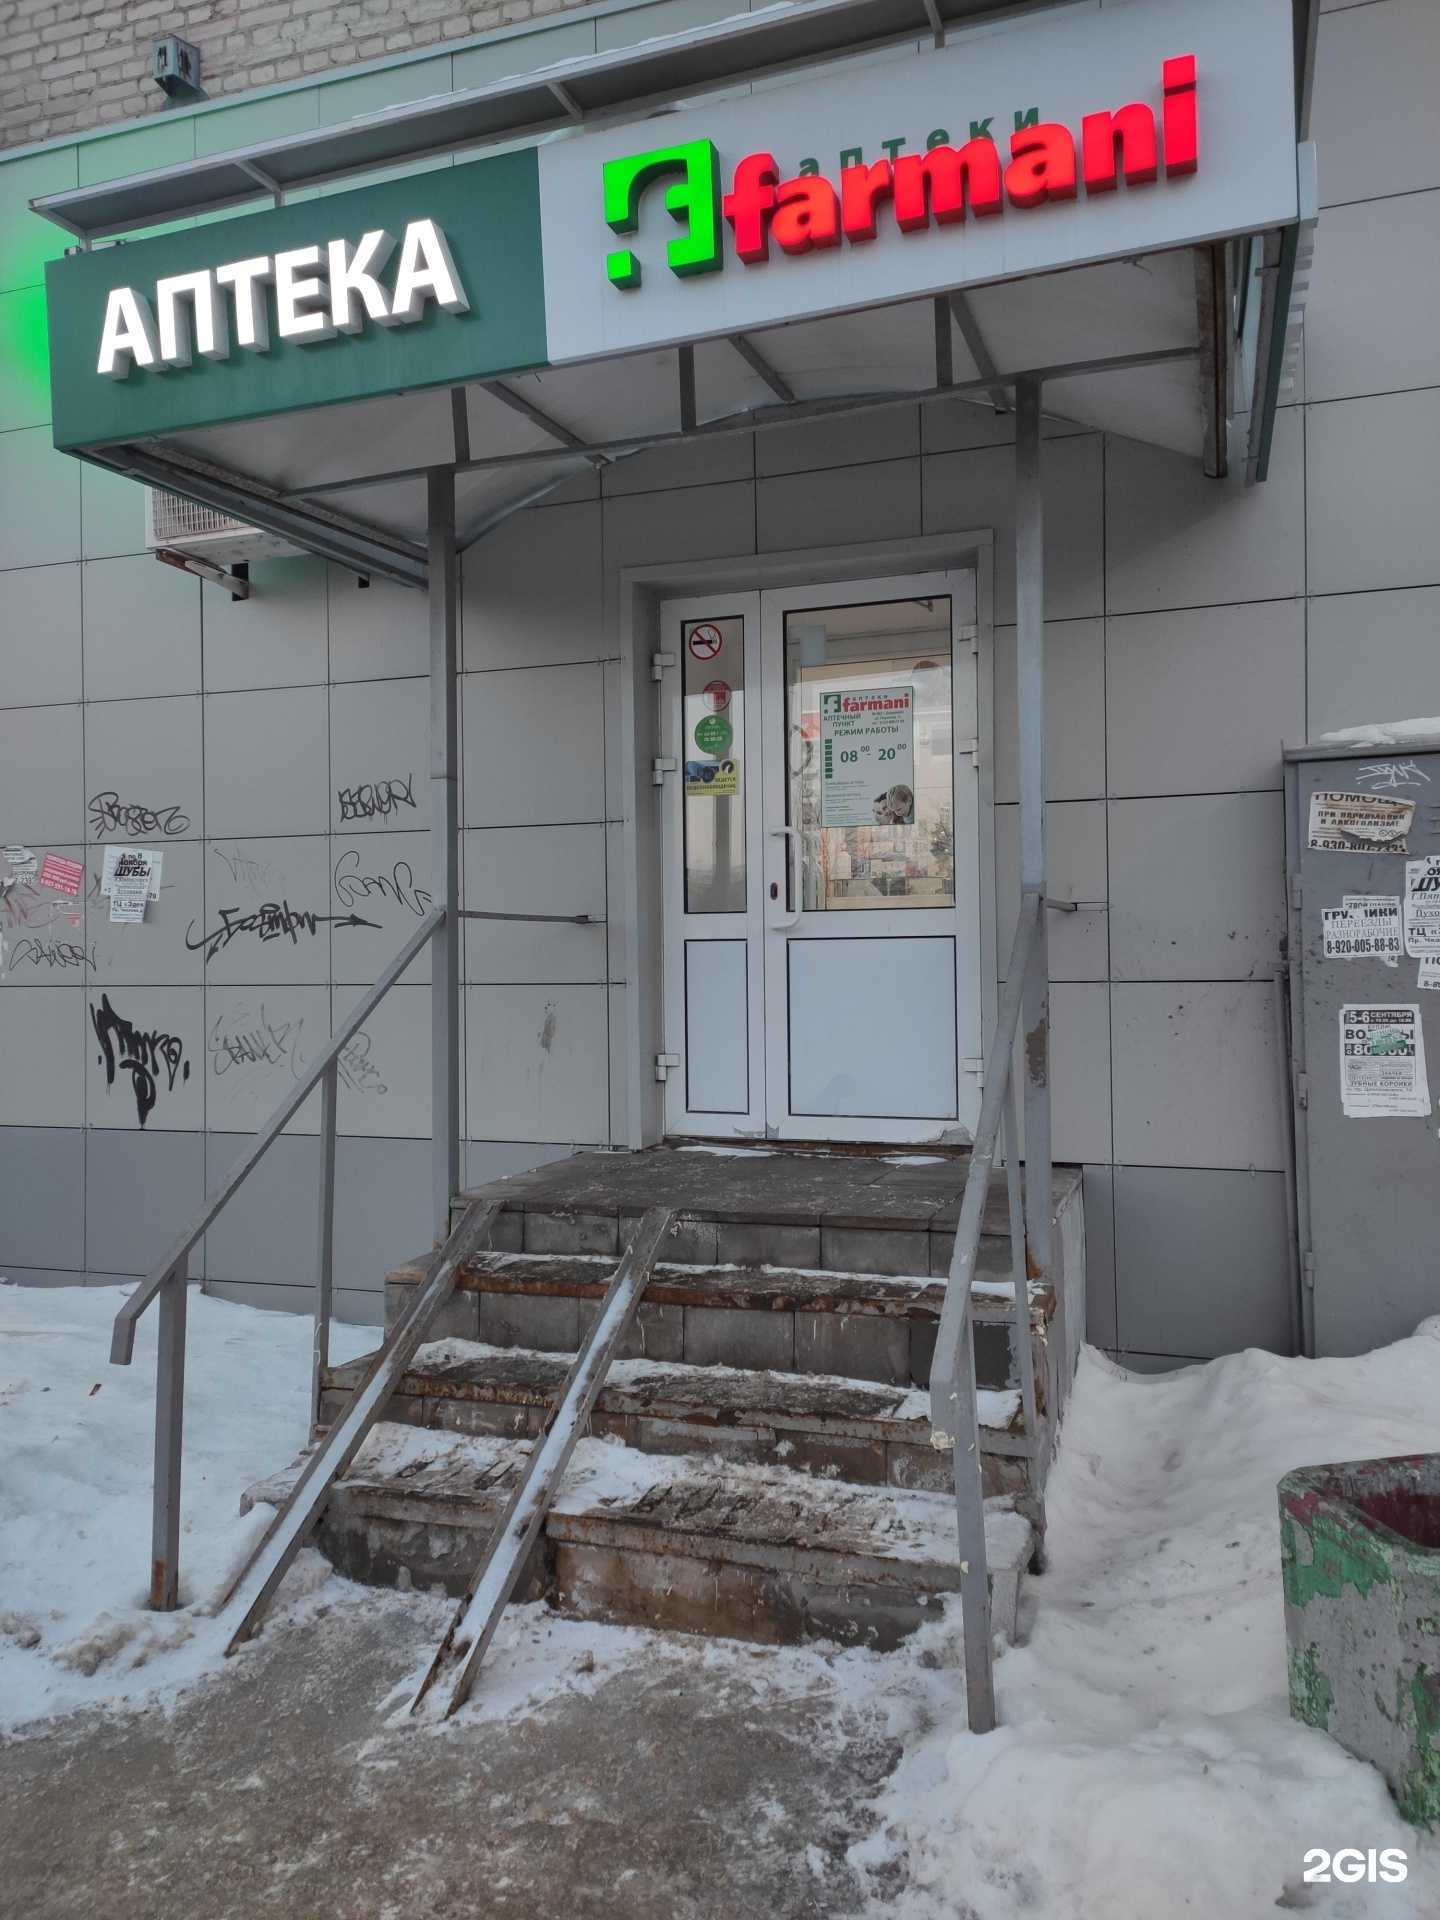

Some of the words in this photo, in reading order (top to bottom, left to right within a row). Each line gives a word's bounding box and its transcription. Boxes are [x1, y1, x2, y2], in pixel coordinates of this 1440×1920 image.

[799, 106, 1040, 179] аптеки
[723, 53, 1199, 266] farmani
[97, 218, 471, 381] АПТЕКА
[843, 693, 909, 712] farmani
[834, 728, 864, 736] РЕЖИМ
[865, 726, 899, 735] РАБОТЫ
[840, 750, 858, 763] 08
[878, 748, 896, 761] 20
[114, 867, 151, 876] ШУБЫ
